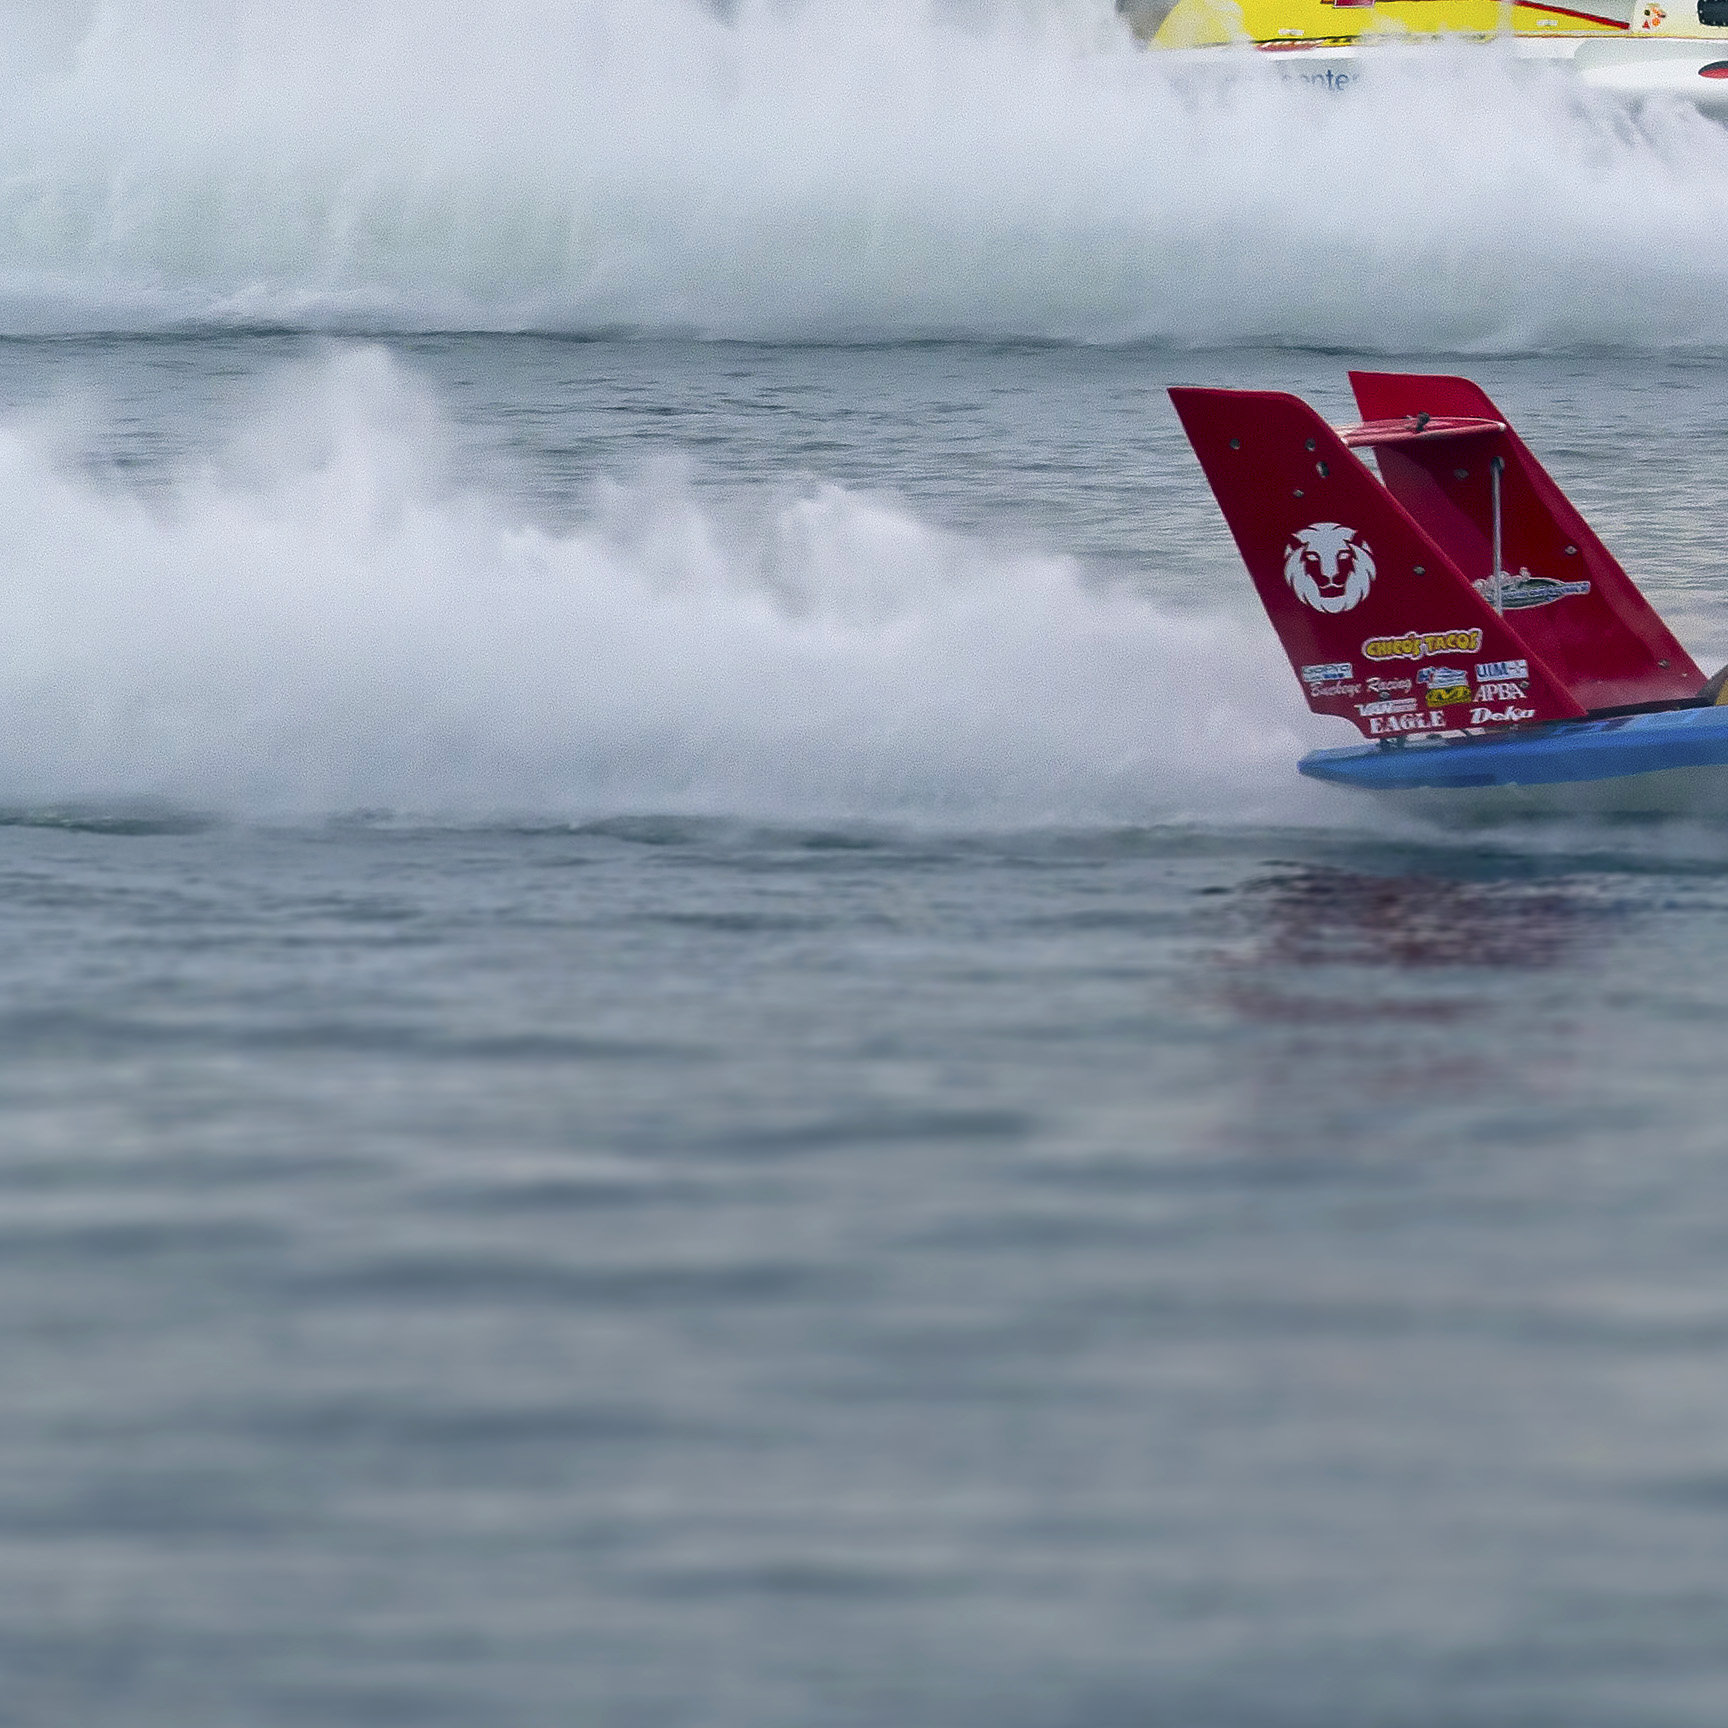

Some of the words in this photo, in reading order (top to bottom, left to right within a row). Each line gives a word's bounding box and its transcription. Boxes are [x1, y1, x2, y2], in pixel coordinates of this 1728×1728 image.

[1424, 631, 1479, 651] TACOS
[1472, 682, 1527, 703] APBA
[1369, 710, 1447, 734] EAGLE
